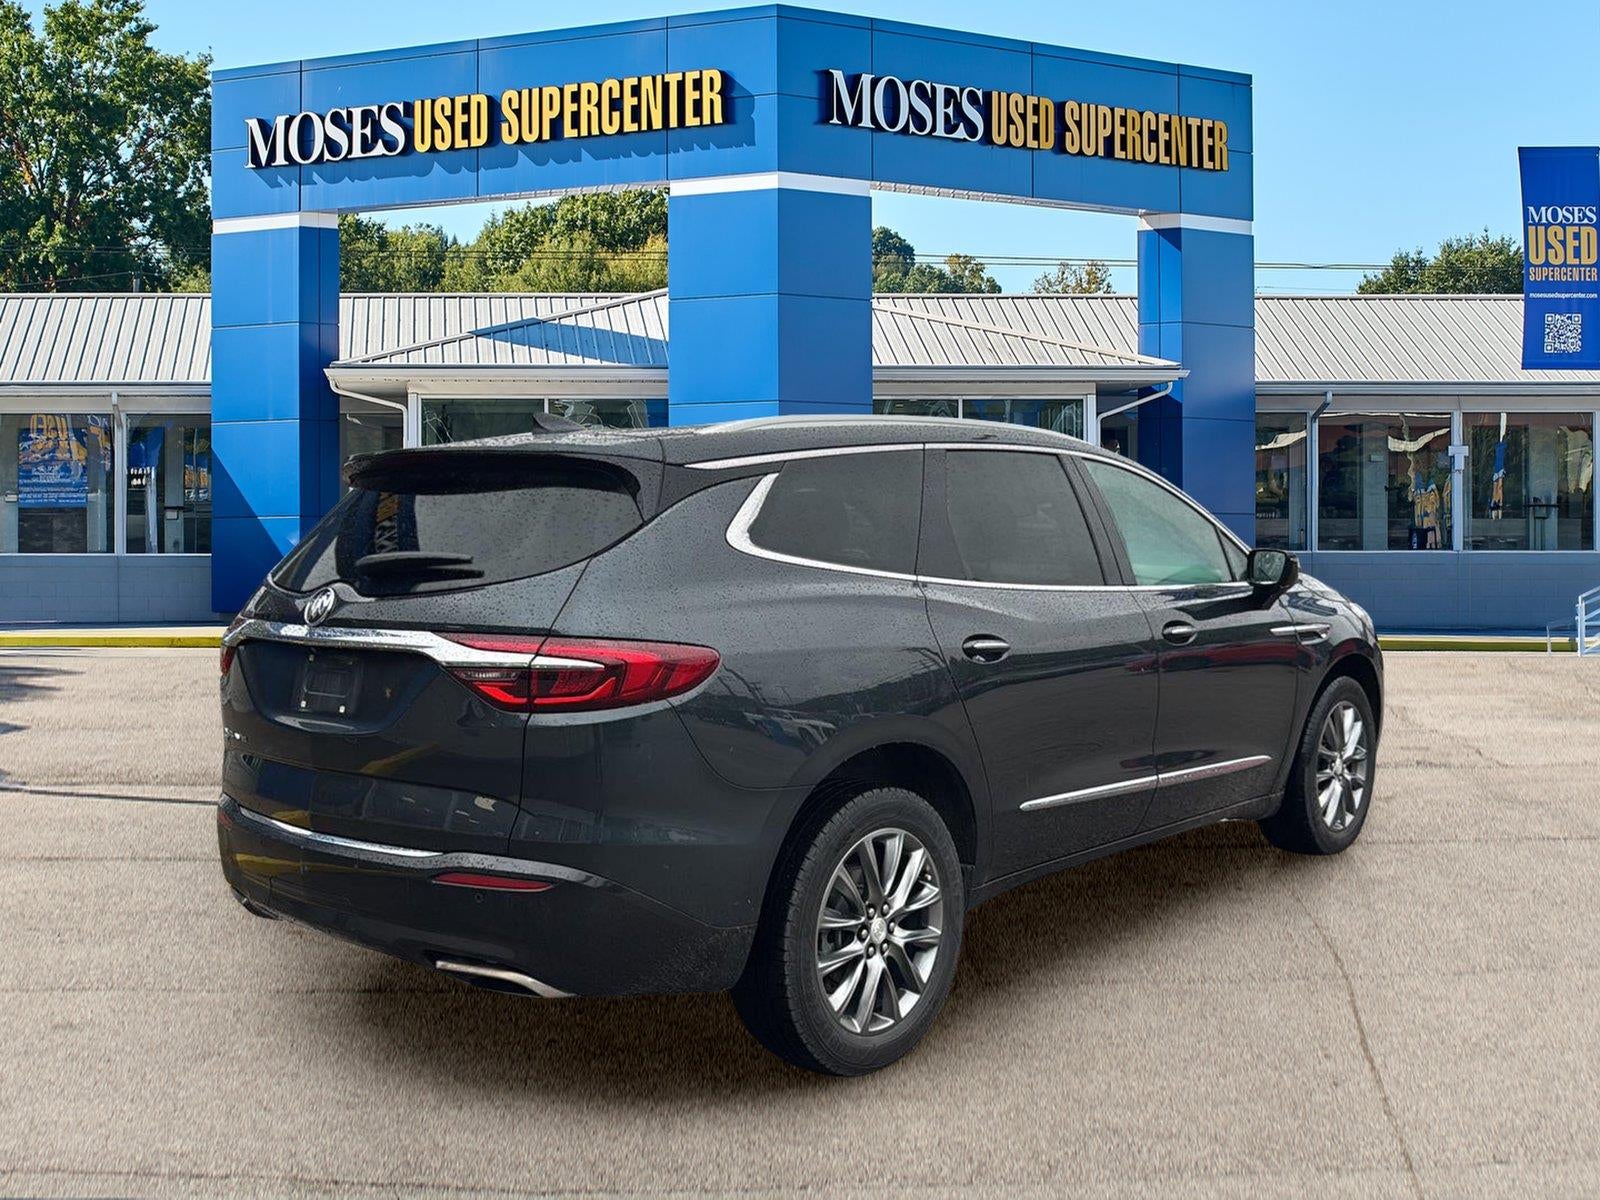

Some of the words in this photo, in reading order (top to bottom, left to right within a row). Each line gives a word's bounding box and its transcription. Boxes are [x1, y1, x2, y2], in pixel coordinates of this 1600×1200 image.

[244, 102, 406, 169] MOSES
[413, 93, 489, 153] USED
[501, 69, 724, 145] SUPERCENTER
[828, 69, 985, 142] MOSES
[991, 90, 1055, 151] USED
[1065, 100, 1229, 171] SUPERCENTER
[1527, 205, 1597, 224] MOSES
[1528, 225, 1598, 266] USED
[1529, 266, 1598, 282] SUPERCENTER
[1529, 291, 1598, 299] mosesusedsupercenter.com
